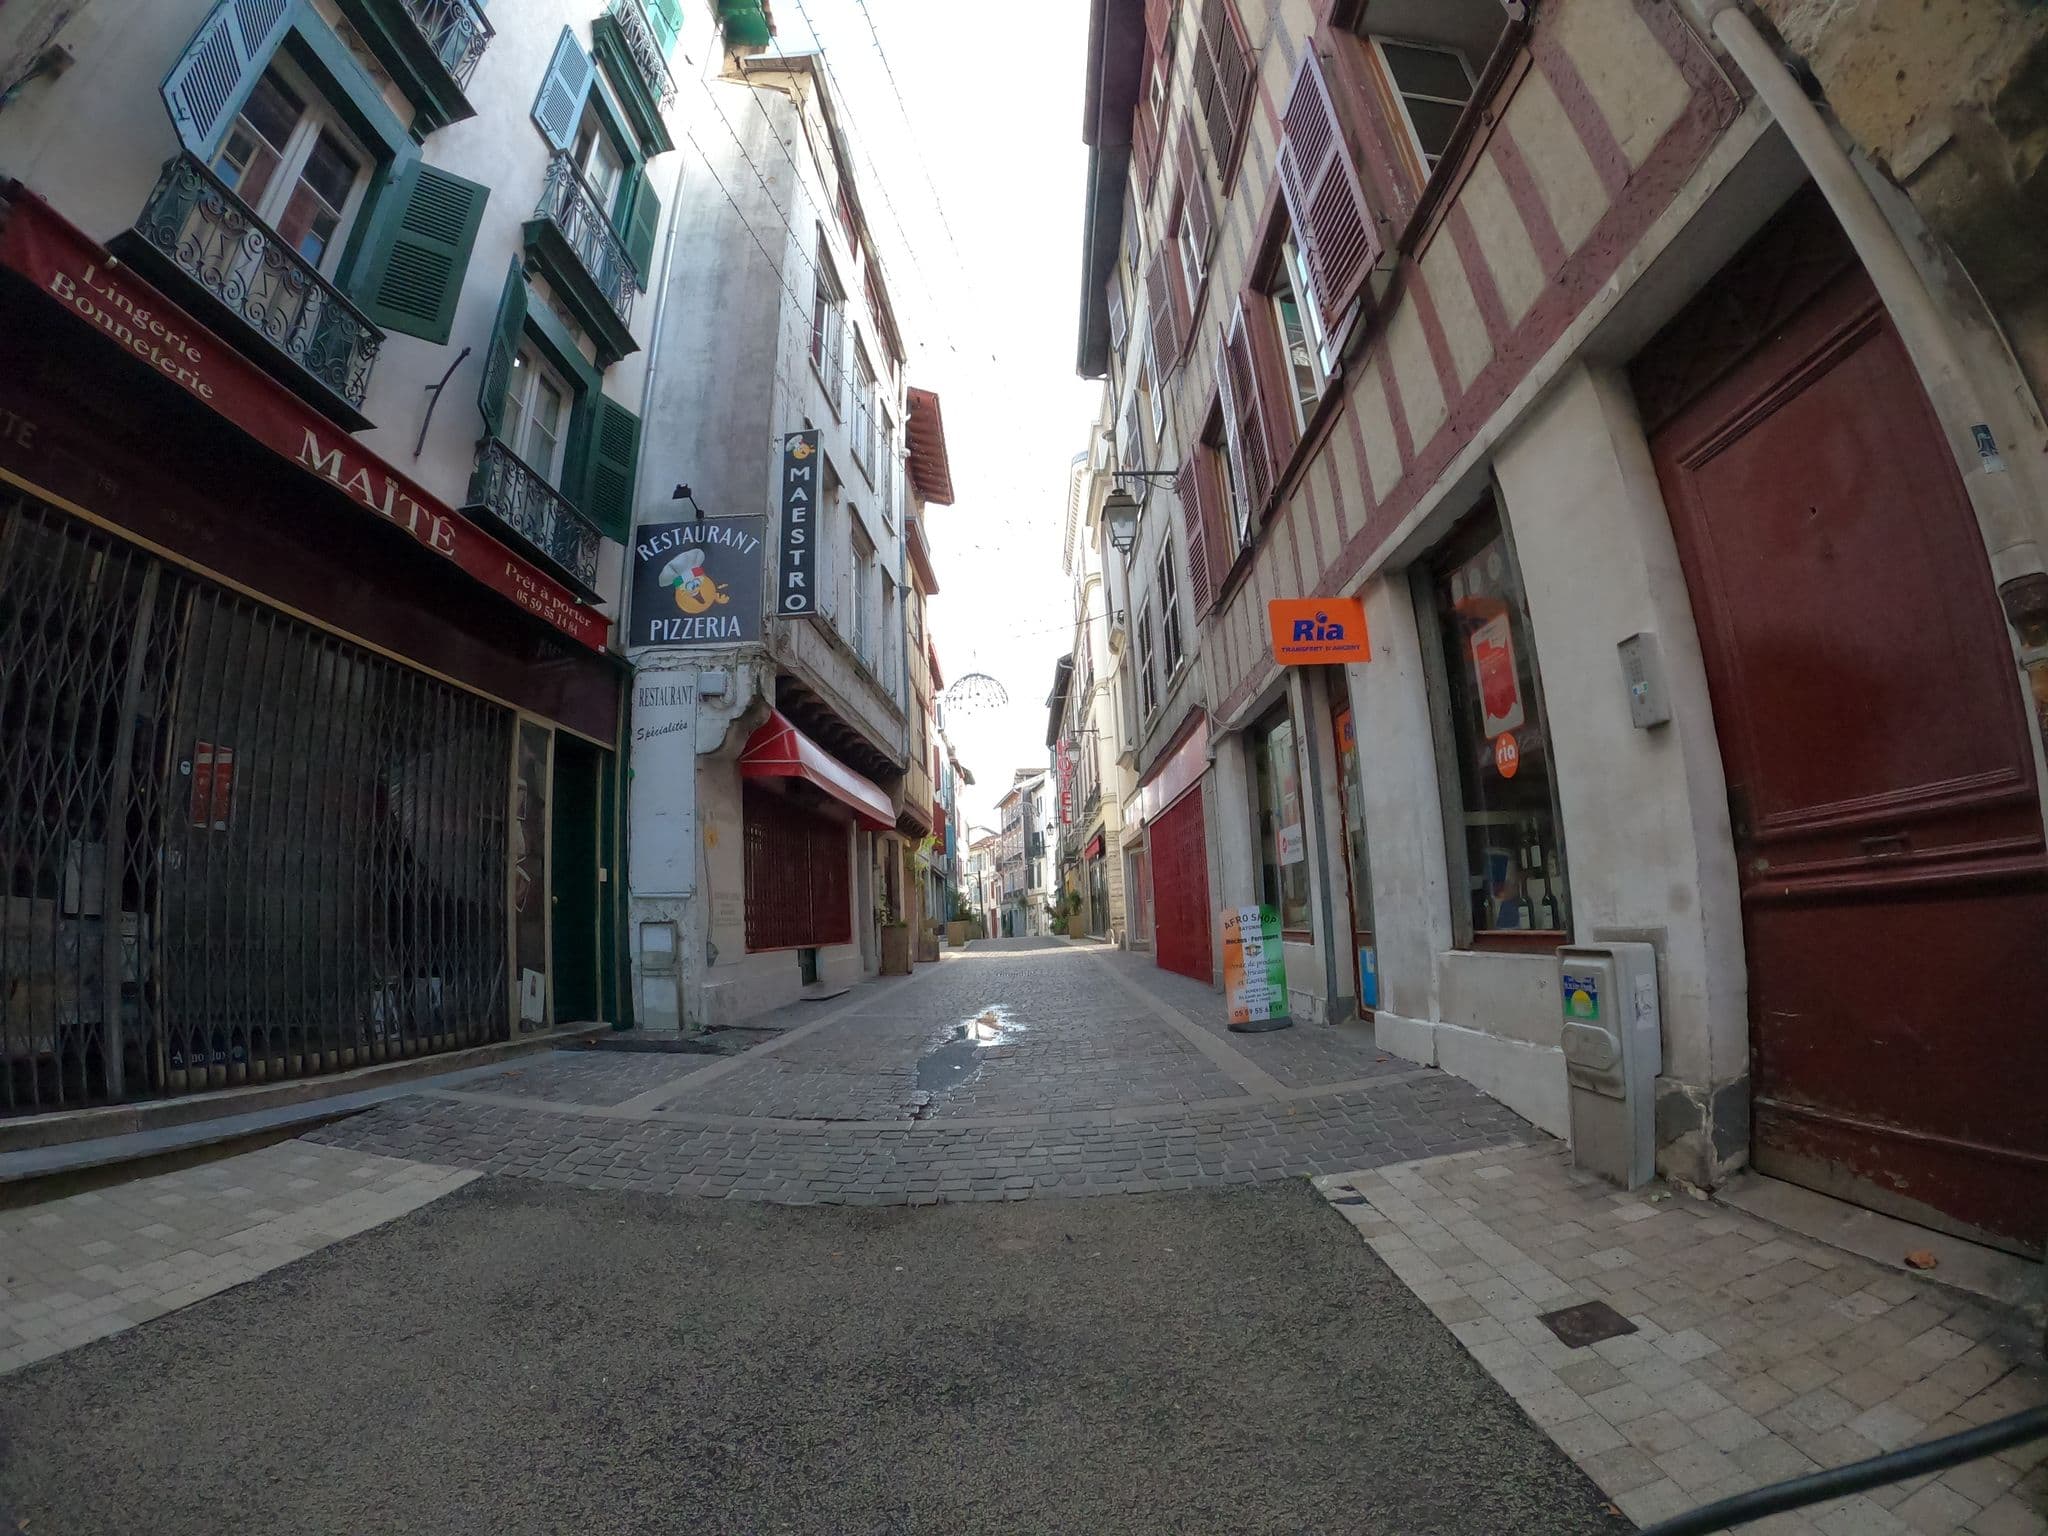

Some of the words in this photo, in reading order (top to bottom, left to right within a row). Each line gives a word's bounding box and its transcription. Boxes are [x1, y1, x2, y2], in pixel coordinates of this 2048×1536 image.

[83, 264, 202, 363] Lingerie
[50, 271, 214, 399] Bonneterie
[637, 525, 760, 563] RESTAURANT
[785, 466, 811, 611] MAESTRO
[516, 588, 529, 605] 05
[530, 597, 543, 612] 59
[544, 605, 556, 620] 55
[650, 615, 741, 641] PIZZERIA
[1293, 611, 1344, 641] Ria
[638, 685, 694, 707] RESTAURANT
[1498, 738, 1517, 764] ria
[1224, 913, 1248, 930] AFRO
[1251, 912, 1277, 924] SHOP
